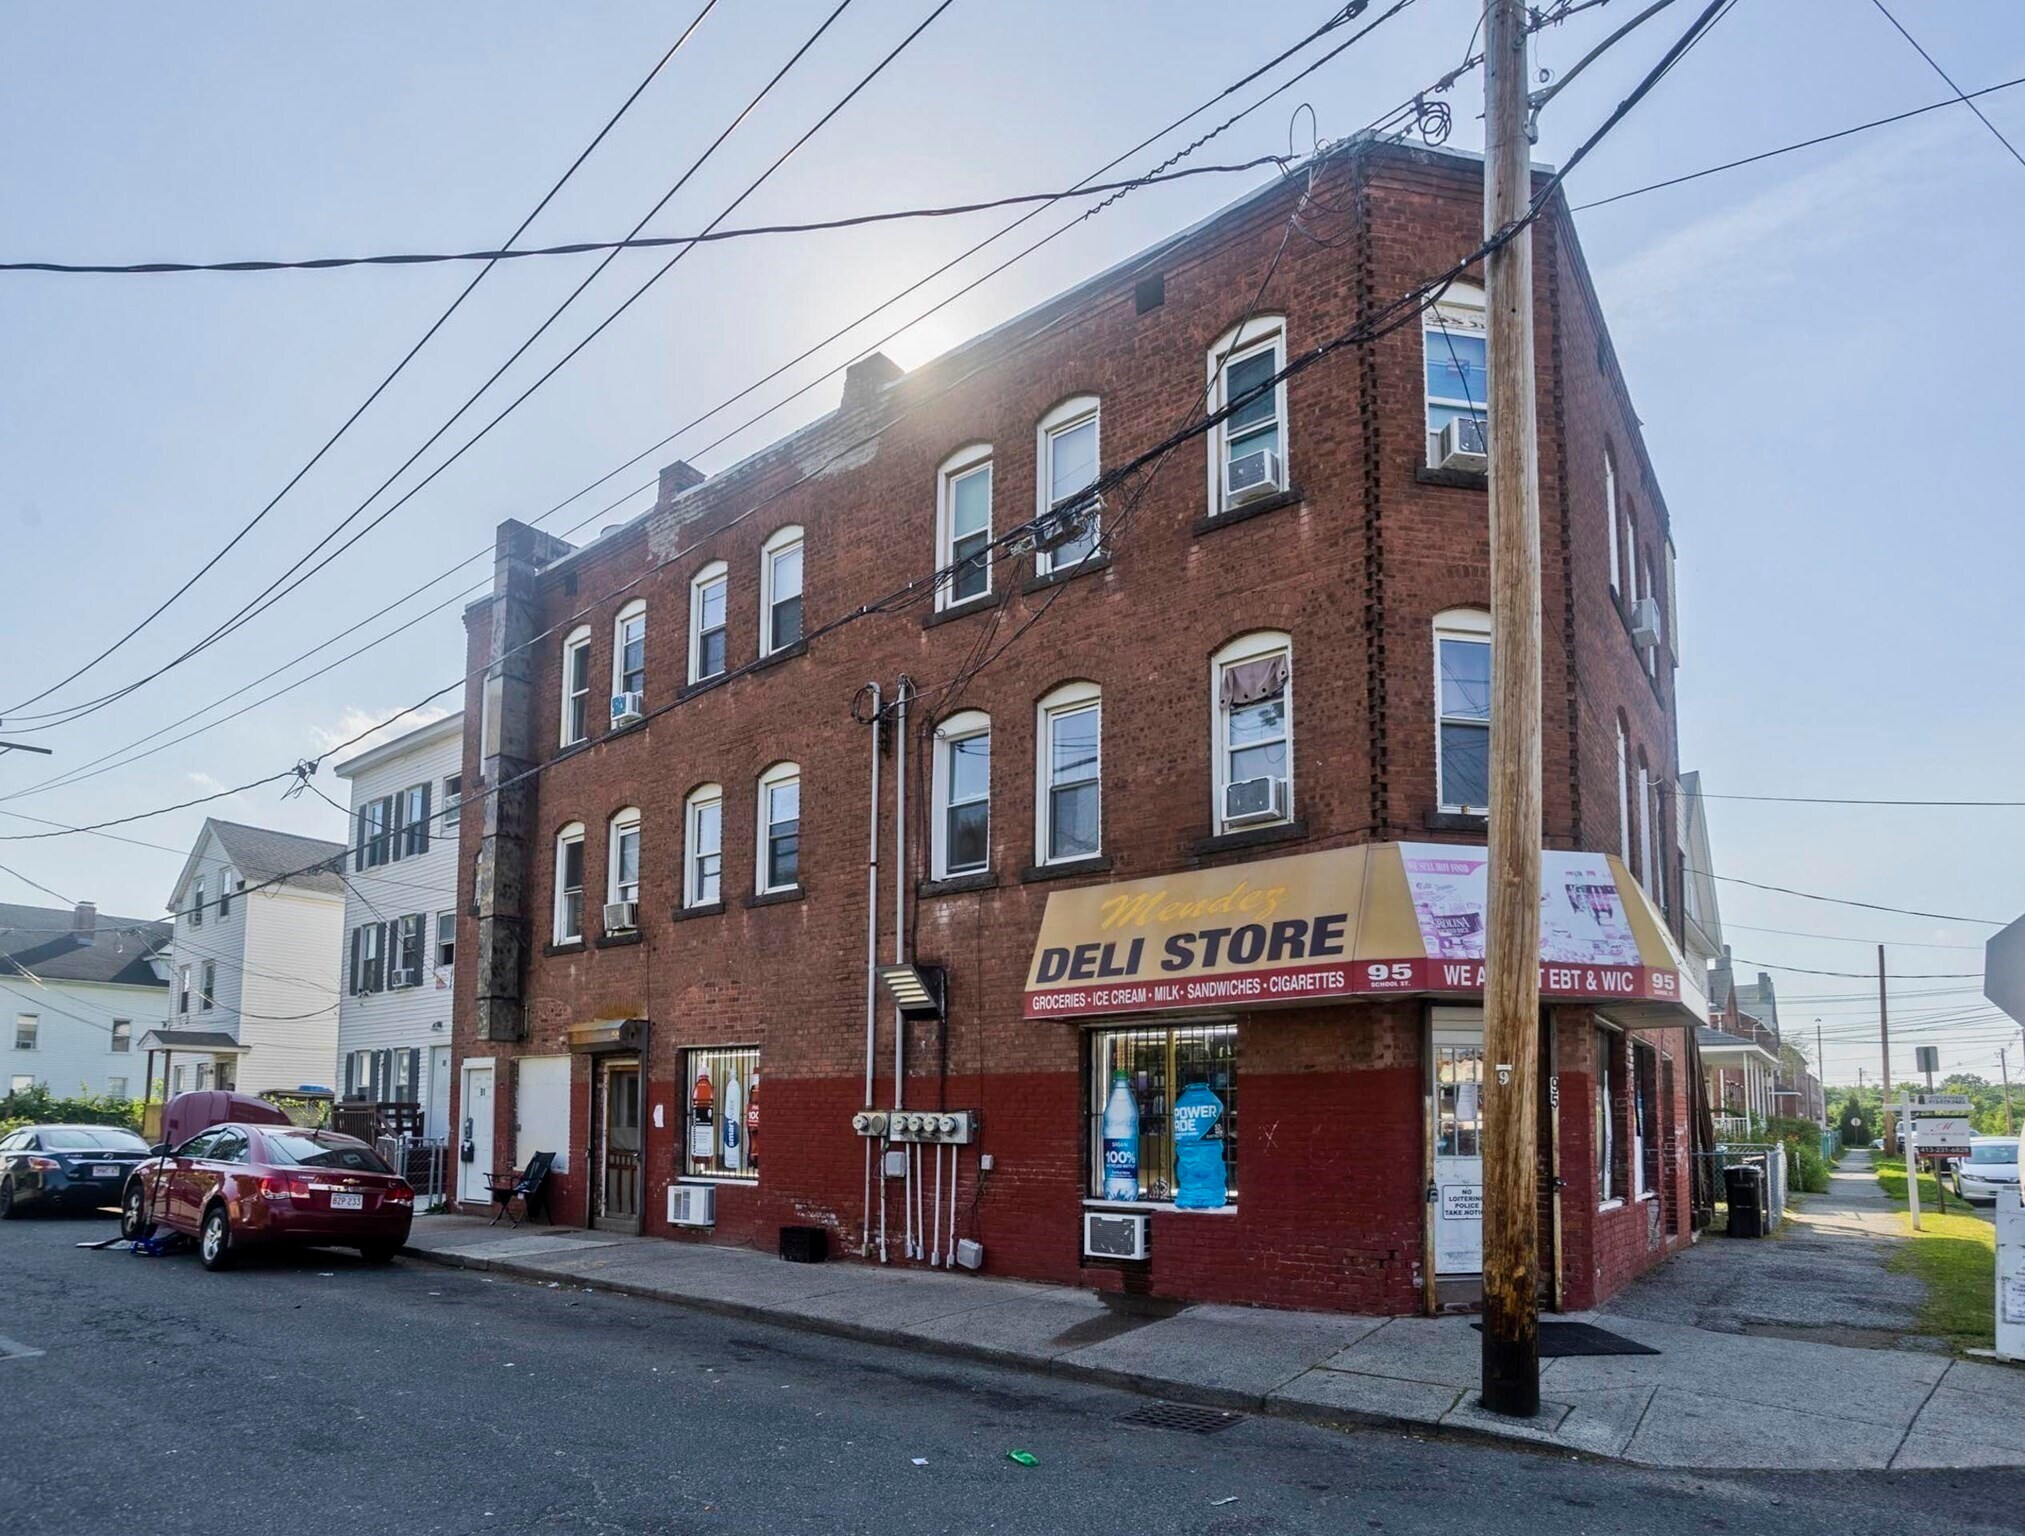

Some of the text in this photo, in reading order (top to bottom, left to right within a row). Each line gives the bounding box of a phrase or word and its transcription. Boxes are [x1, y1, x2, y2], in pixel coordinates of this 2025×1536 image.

[1101, 881, 1287, 930] Mendez
[1035, 913, 1348, 984] DELI STORE
[1367, 963, 1413, 980] 95
[1443, 965, 1472, 986] WE
[1549, 968, 1582, 990] EBT
[1585, 970, 1598, 991] &
[1601, 971, 1634, 992] WIC
[1651, 972, 1675, 990] 95
[1032, 971, 1345, 1010] GROCERIES ICE CREAM MILK SANDWICHES CIGARETTES
[1498, 1071, 1510, 1086] 9
[1174, 1105, 1217, 1119] POWER
[1174, 1119, 1197, 1132] ADE
[1105, 1150, 1136, 1164] 100%
